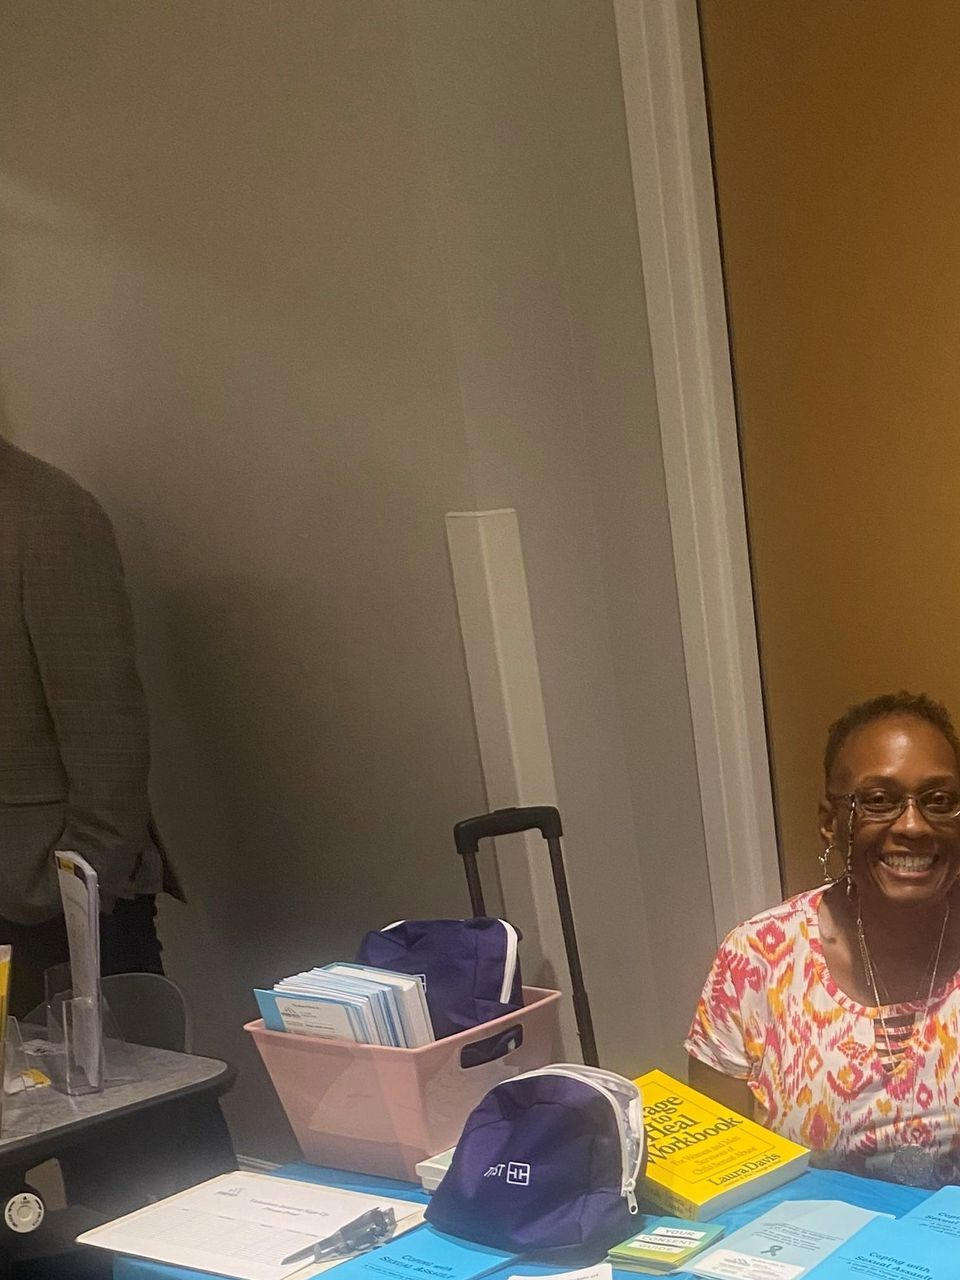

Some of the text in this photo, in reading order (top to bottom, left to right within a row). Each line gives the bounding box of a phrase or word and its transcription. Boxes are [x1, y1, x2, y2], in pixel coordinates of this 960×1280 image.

[644, 1114, 702, 1143] Heal
[651, 1114, 672, 1125] to
[647, 1117, 744, 1165] Workbook
[707, 1166, 749, 1186] Laura
[742, 1152, 782, 1171] Davis
[641, 1235, 695, 1246] CONSENT
[665, 1229, 696, 1237] YOUR
[855, 1255, 891, 1270] Sexual
[869, 1251, 931, 1274] Coping with
